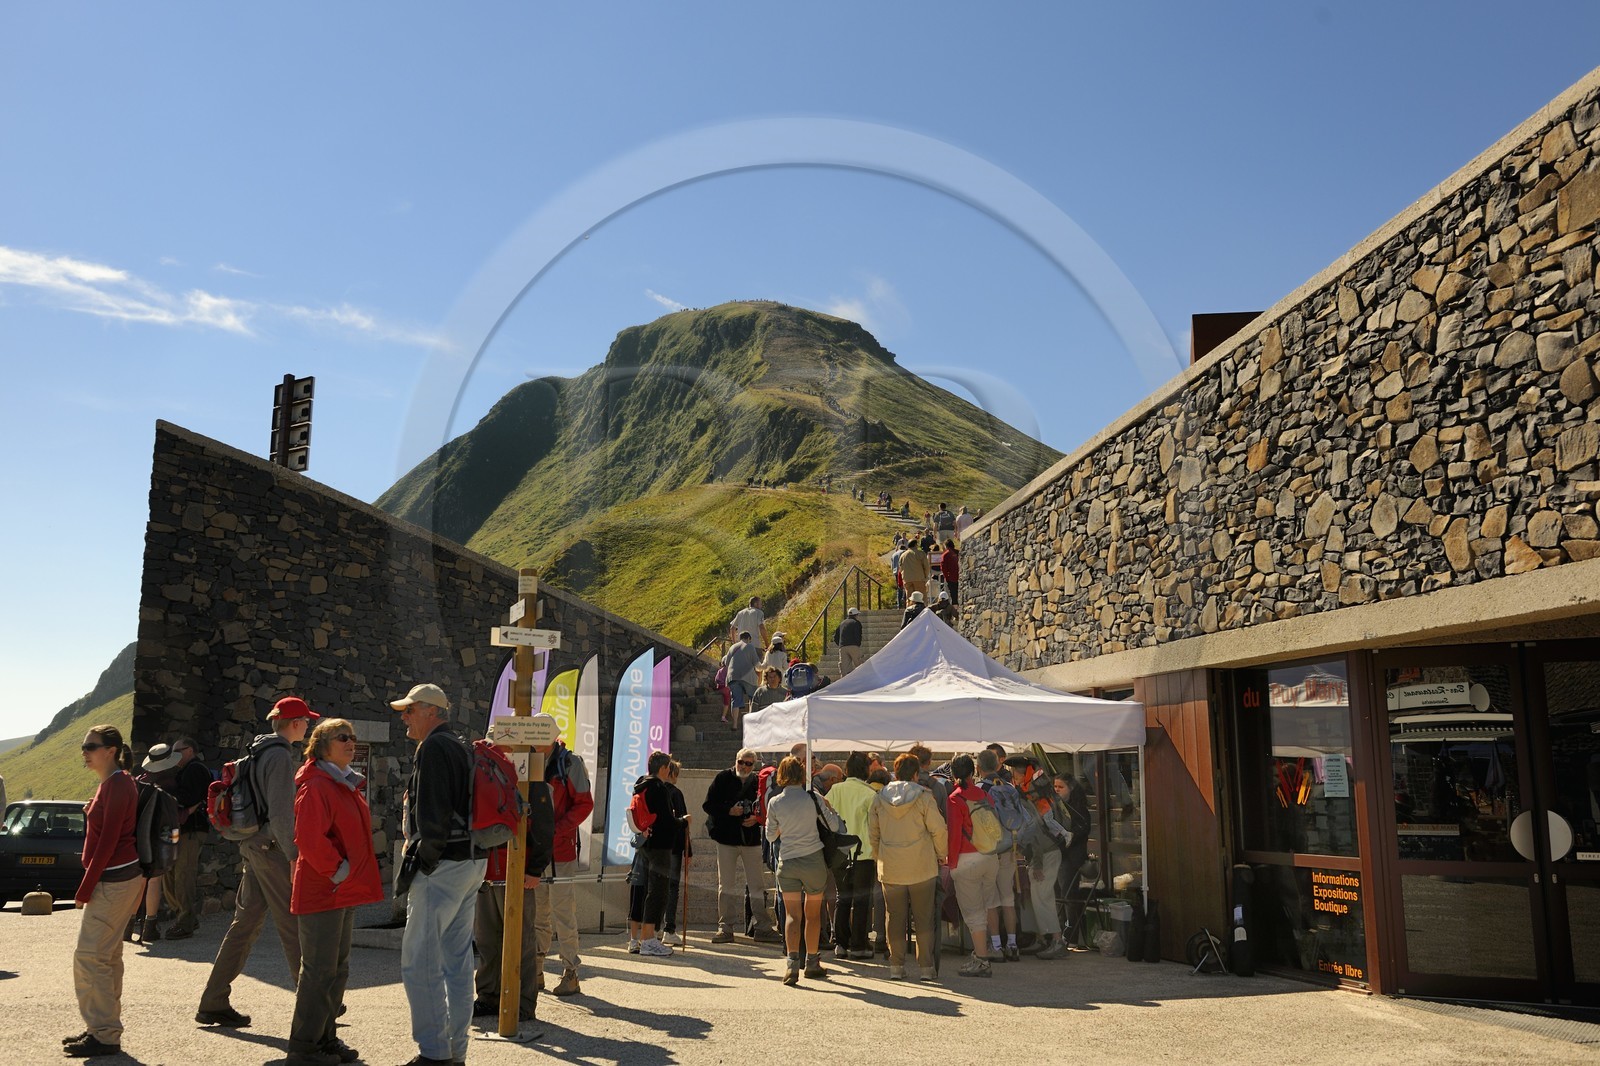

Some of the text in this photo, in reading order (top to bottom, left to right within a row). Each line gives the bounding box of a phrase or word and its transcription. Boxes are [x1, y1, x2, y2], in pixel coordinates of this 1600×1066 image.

[1243, 677, 1343, 709] du Puy Mary
[615, 668, 647, 858] Ble d'Auvergne
[1312, 871, 1359, 887] Informations
[1313, 885, 1358, 901] Expositions
[1314, 899, 1348, 915] Boutique
[1318, 959, 1363, 979] Entrée libre
